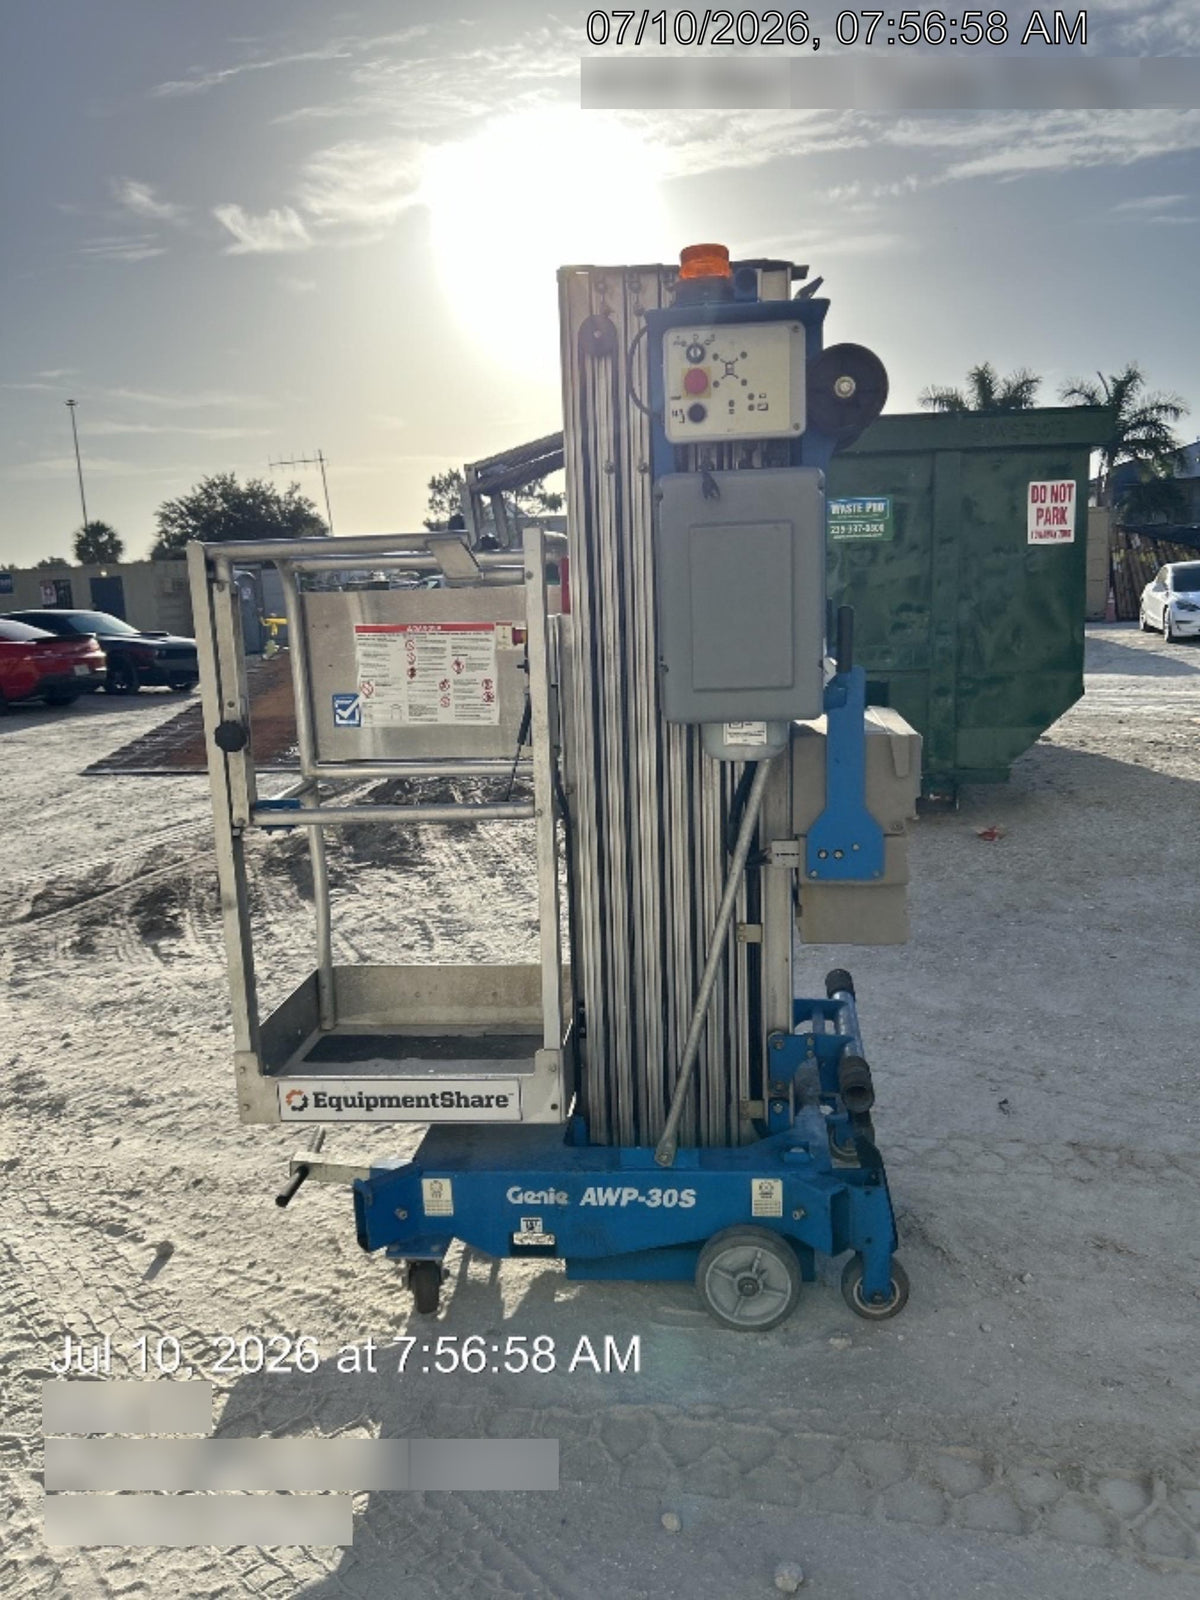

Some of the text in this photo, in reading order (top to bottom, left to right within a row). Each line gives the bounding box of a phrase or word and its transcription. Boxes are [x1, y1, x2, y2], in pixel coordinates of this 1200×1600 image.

[1031, 483, 1074, 503] DO NOT
[1036, 506, 1067, 526] PARK
[312, 1091, 510, 1112] EquipmentShare
[506, 1185, 697, 1209] Genie AWP-30S
